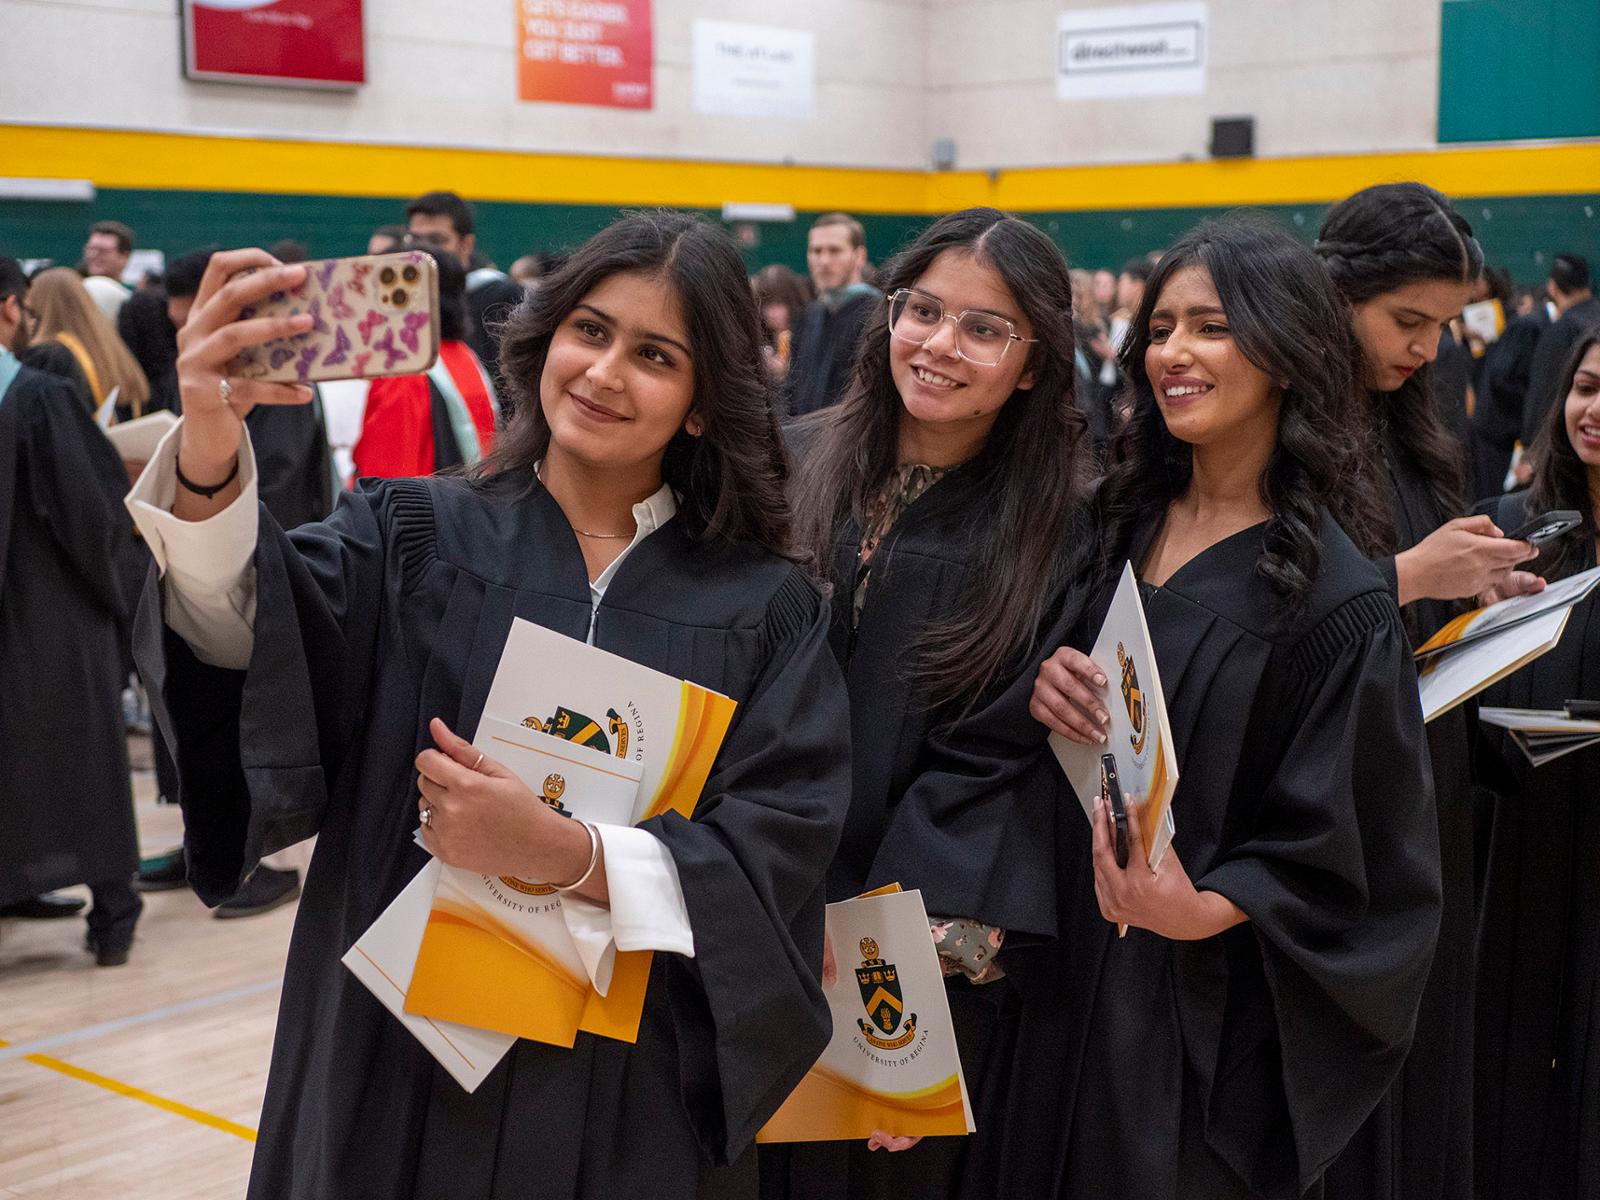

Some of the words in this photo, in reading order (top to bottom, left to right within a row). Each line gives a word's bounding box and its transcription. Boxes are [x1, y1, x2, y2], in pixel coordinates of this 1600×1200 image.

[526, 19, 557, 36] YOU
[563, 22, 603, 41] JUST
[524, 40, 558, 60] GET
[628, 701, 644, 742] REGINA
[636, 747, 643, 761] OF
[528, 906, 540, 914] OF
[544, 900, 562, 913] REG
[853, 1036, 897, 1067] UNIVERSITY
[899, 1056, 909, 1066] OF
[910, 1030, 928, 1060] REGINA
